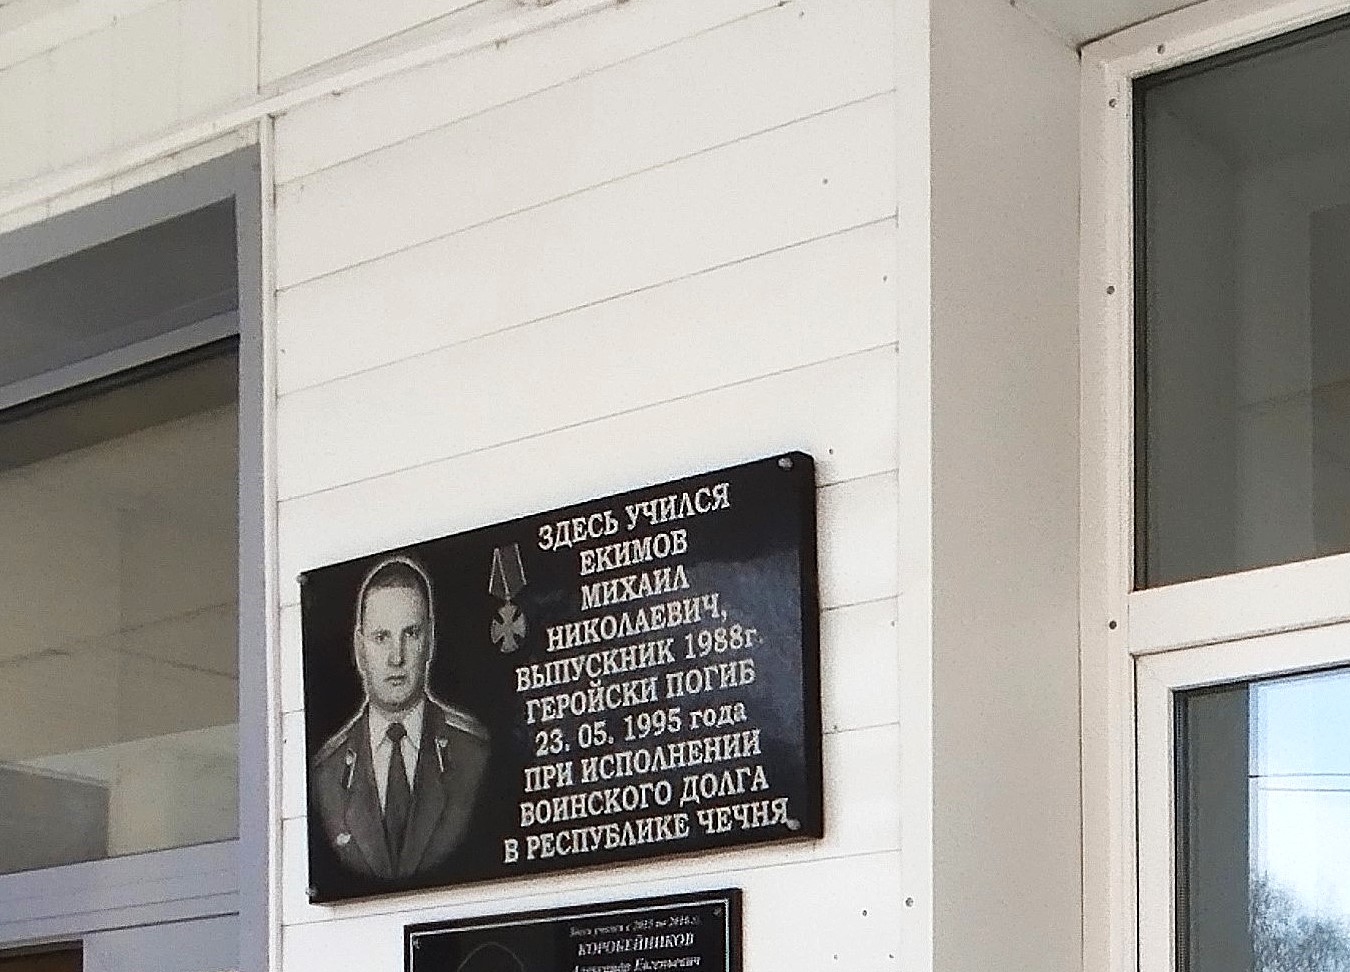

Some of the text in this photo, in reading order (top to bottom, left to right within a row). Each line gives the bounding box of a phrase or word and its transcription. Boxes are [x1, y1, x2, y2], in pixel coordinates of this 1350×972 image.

[537, 482, 732, 552] ЗДЕСЬ УЧИЛСЯ
[579, 528, 688, 576] ЕКИМОВ
[580, 564, 690, 611] МИХАИЛ
[546, 592, 728, 653] НИКОЛАЕВИЧ,
[516, 625, 764, 693] ВЫПУСКНИК 1988г.
[525, 658, 757, 725] ГЕРОЙСКИ ПОГИБ
[524, 729, 762, 793] ПРИ ИСПОЛНЕНИИ
[534, 702, 748, 757] 23. 05. 1995 года
[519, 765, 769, 827] ВОИНСКОГО ДОЛГА
[503, 797, 789, 864] В РЕСПУБЛИКЕ ЧЕЧНЯ
